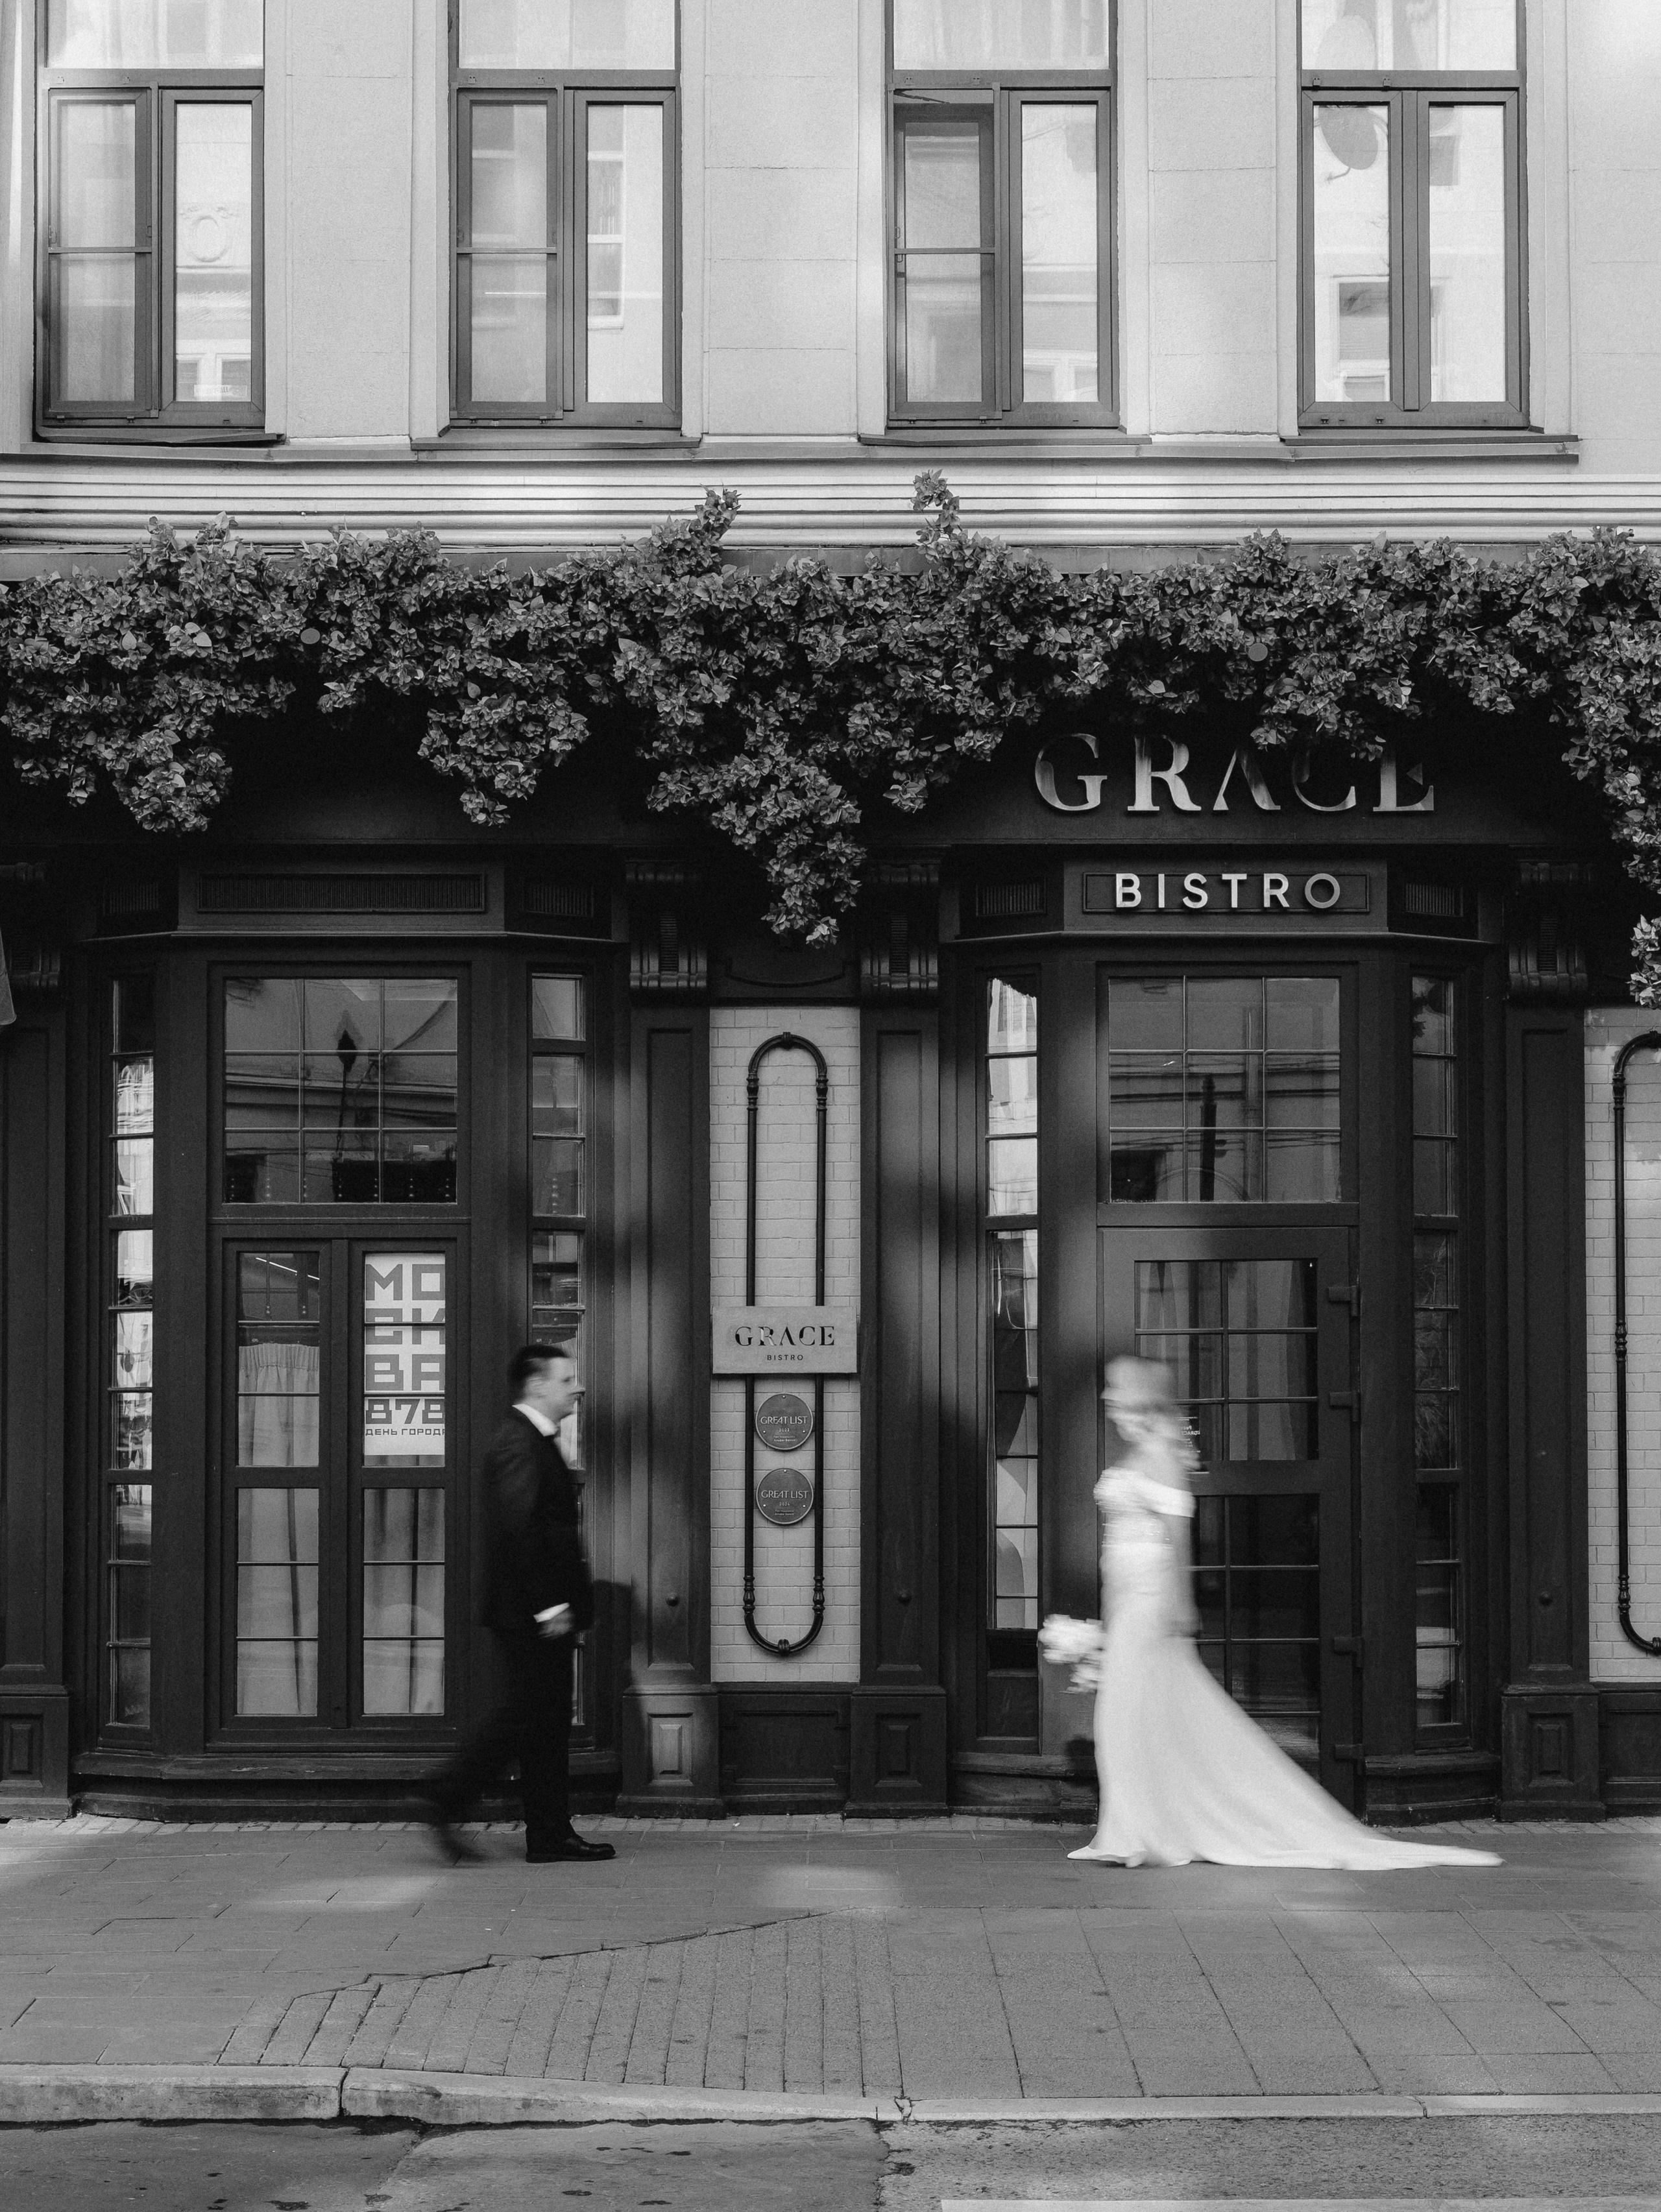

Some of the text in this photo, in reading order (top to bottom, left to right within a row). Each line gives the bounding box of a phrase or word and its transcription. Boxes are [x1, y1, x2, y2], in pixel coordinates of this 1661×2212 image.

[1034, 732, 1435, 811] GRACE
[1115, 872, 1340, 909] BISTRO
[734, 1325, 835, 1347] GRACE
[365, 1399, 445, 1425] 878
[760, 1415, 808, 1425] GREAT LIST
[761, 1489, 808, 1499] GREAT LIST
